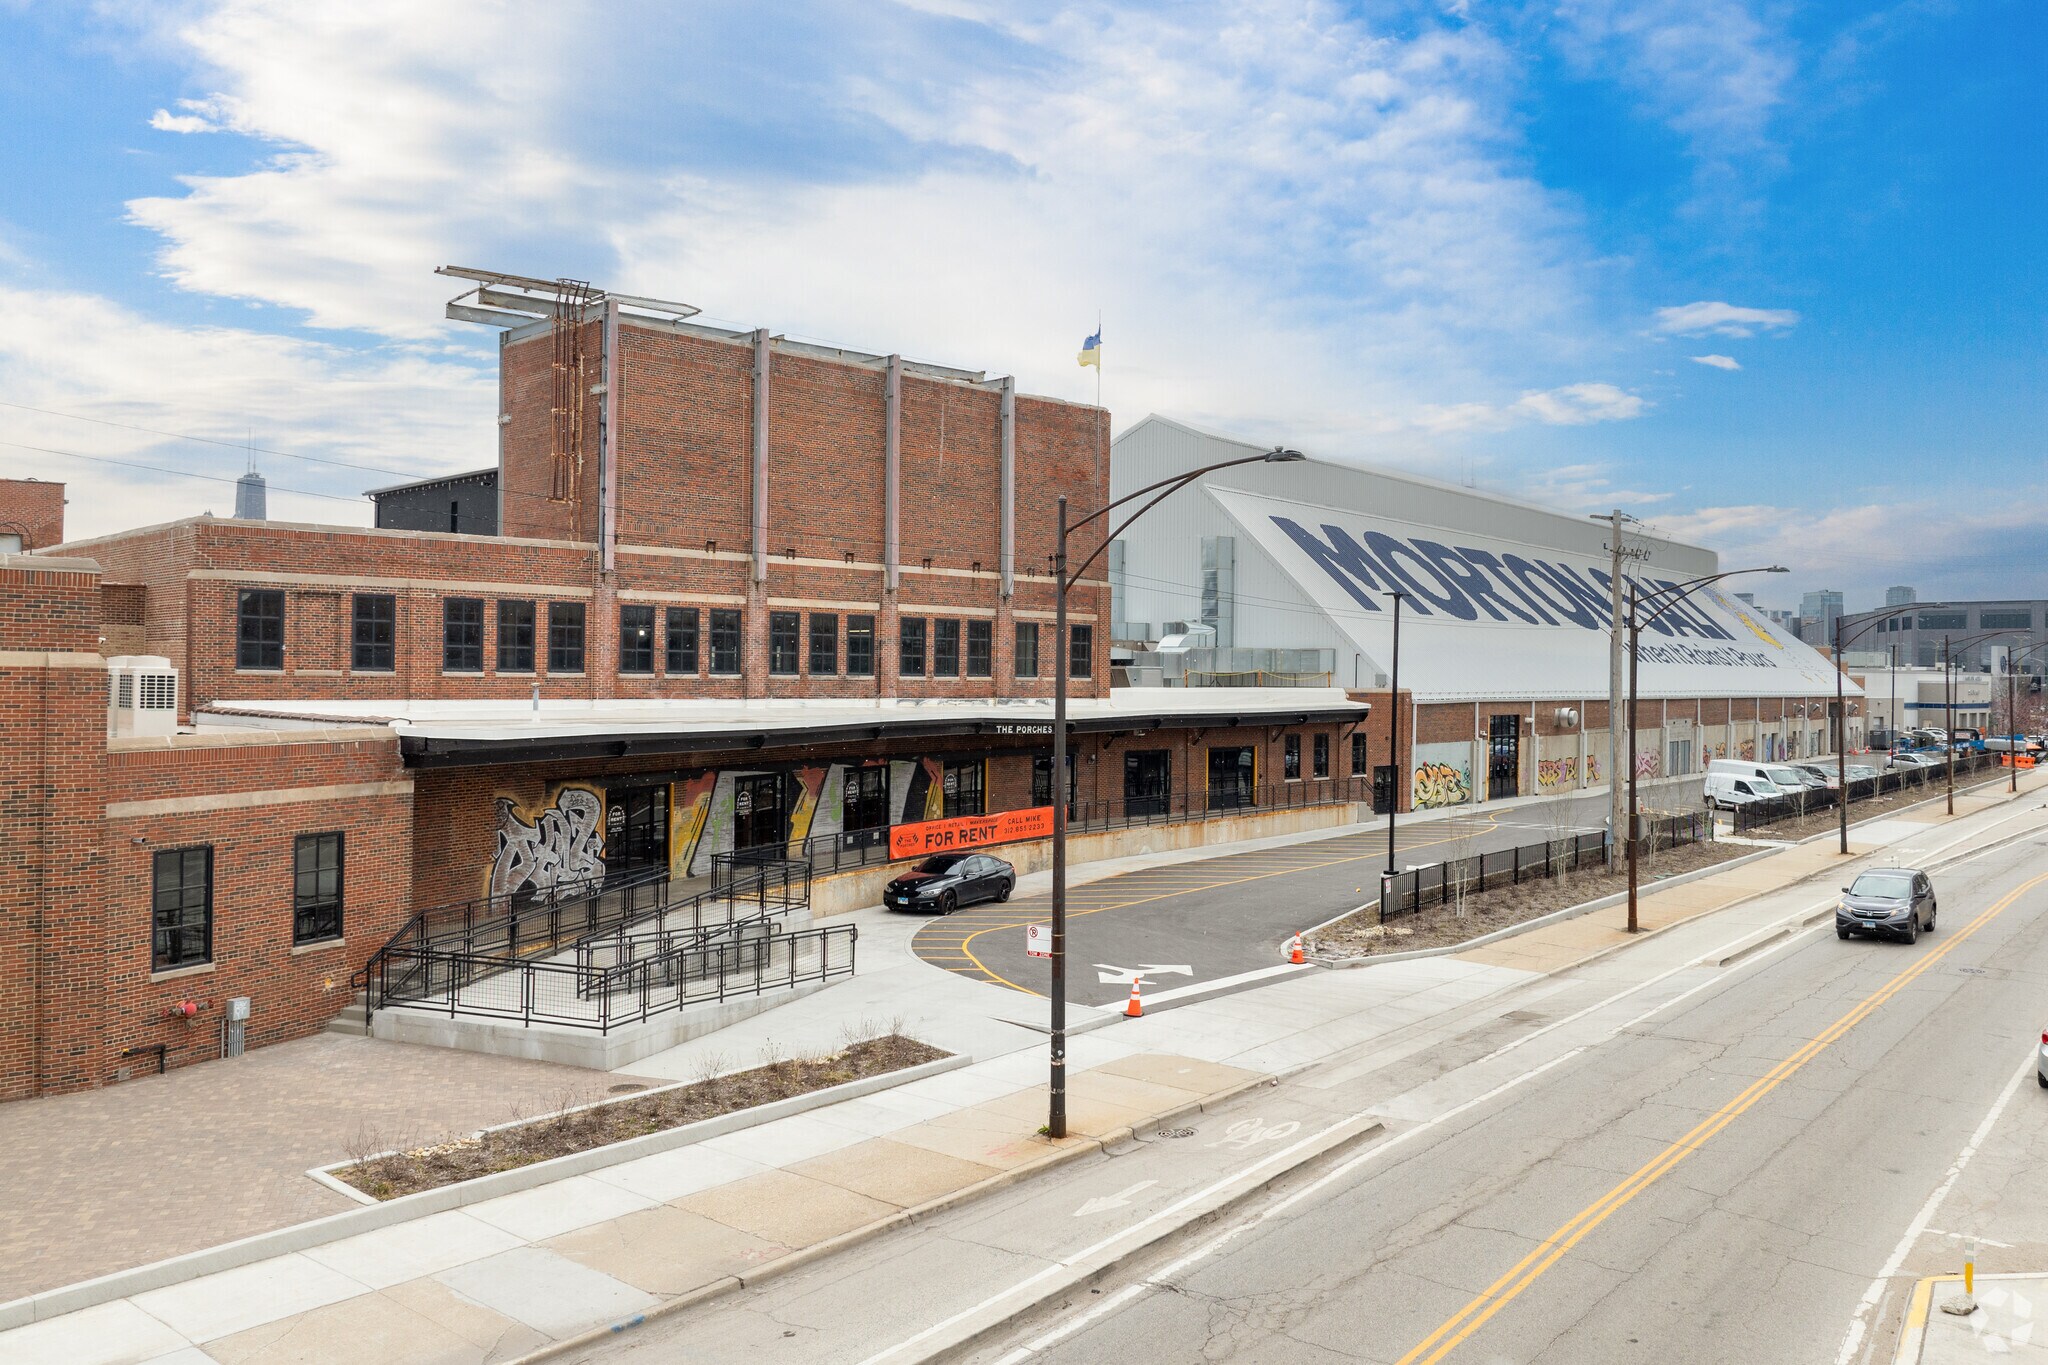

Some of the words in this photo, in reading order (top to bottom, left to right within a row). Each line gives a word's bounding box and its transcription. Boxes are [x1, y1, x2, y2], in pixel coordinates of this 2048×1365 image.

[1268, 515, 1631, 632] MORTON
[1588, 567, 1737, 640] SALT
[1677, 643, 1732, 667] Rains
[1727, 647, 1777, 668] Pours
[996, 725, 1013, 734] THE
[1016, 725, 1053, 734] PORCHES
[1008, 817, 1023, 825] CALL
[925, 831, 954, 849] FOR
[959, 825, 998, 844] RENT
